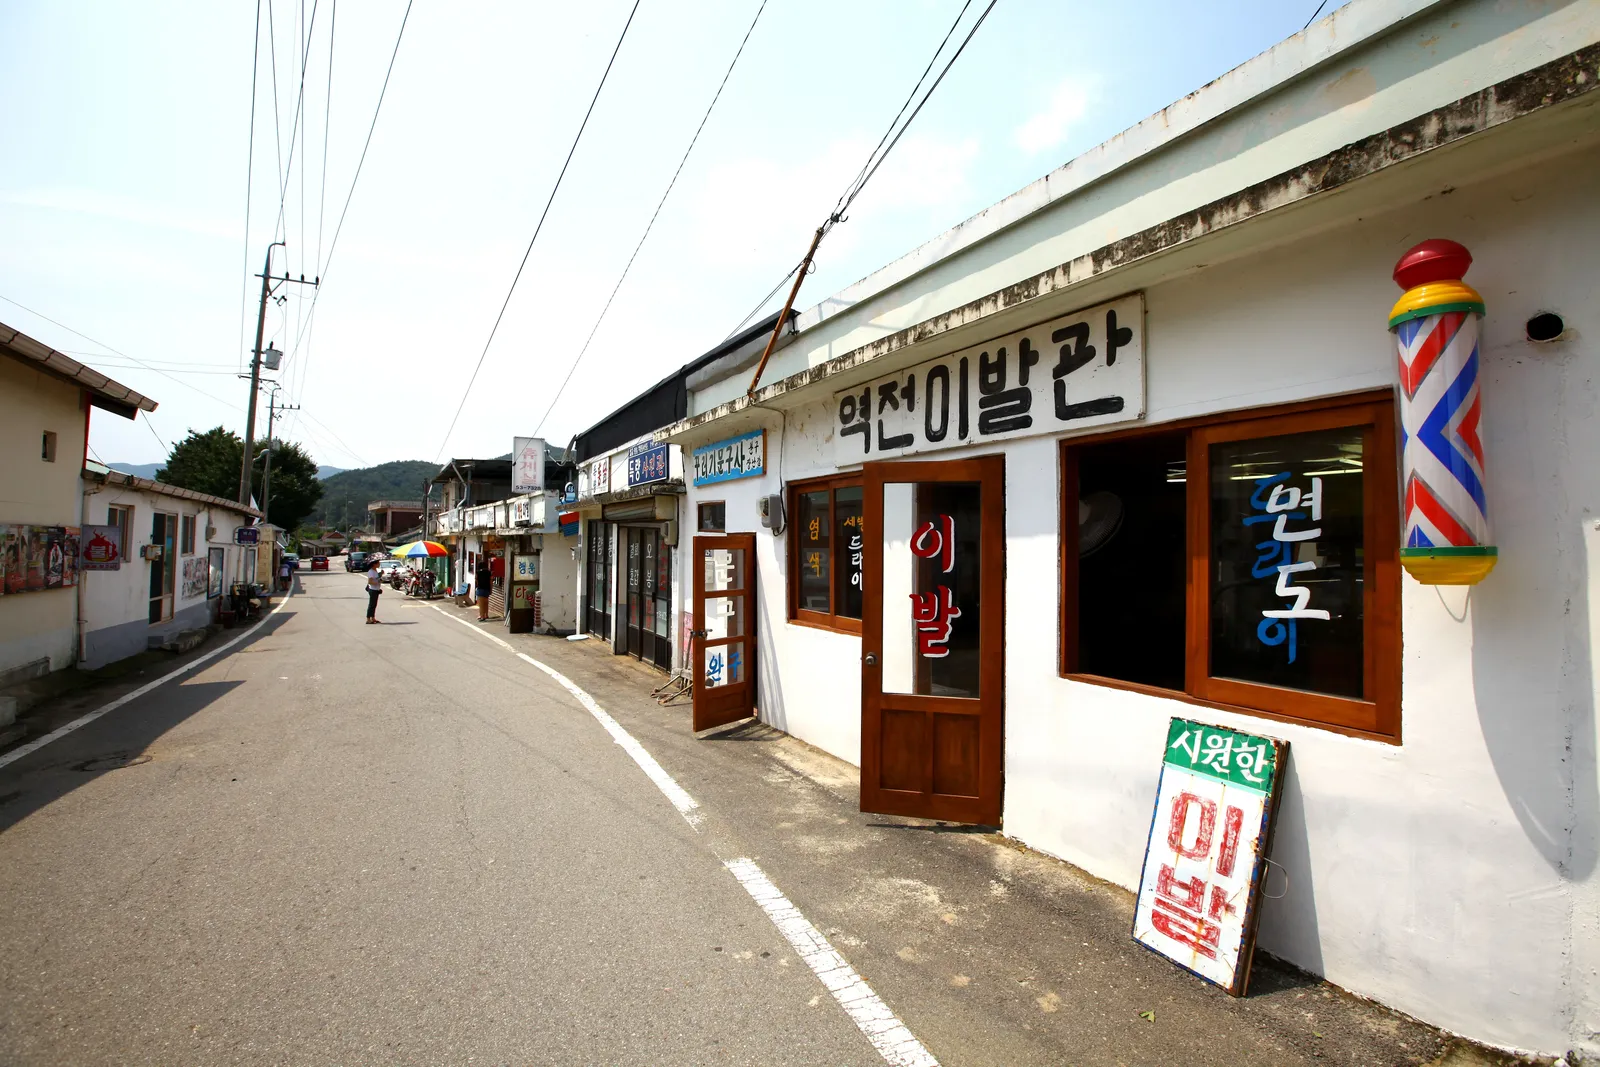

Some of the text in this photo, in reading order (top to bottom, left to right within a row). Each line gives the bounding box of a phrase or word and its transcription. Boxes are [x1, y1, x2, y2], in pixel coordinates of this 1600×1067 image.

[839, 309, 1133, 454] 역전이발관
[629, 458, 641, 483] 득량
[641, 450, 665, 478] 사진관
[694, 441, 746, 482] 꾸러기문구사
[809, 516, 821, 578] 염색
[1262, 477, 1331, 621] 면도
[909, 513, 962, 658] 이발
[708, 651, 742, 682] 완구
[1171, 729, 1268, 783] 시원한
[1151, 789, 1245, 961] 이발
